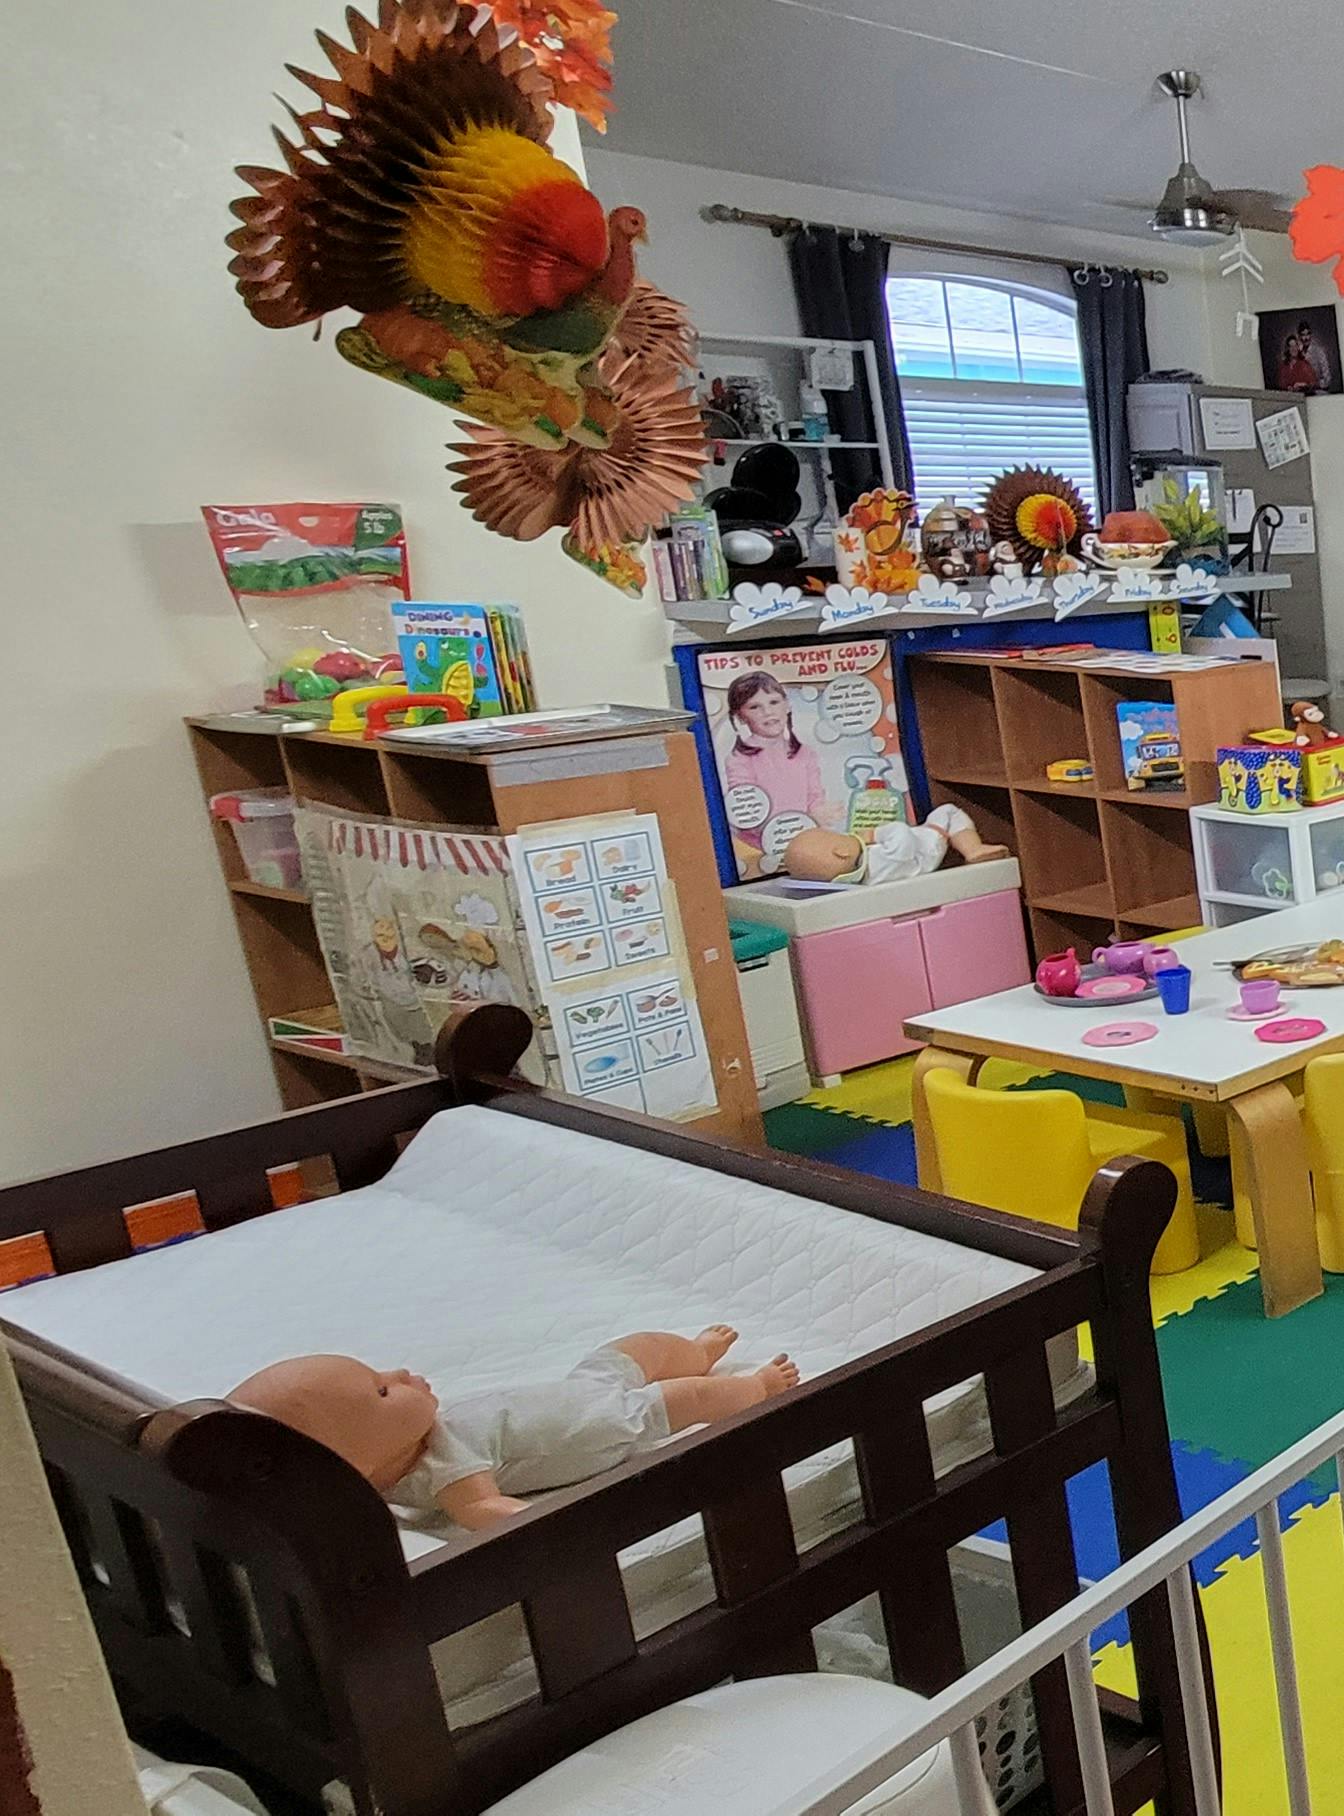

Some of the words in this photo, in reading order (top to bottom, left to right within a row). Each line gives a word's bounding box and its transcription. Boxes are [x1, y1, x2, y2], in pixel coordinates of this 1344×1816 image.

[748, 599, 794, 620] Sunday
[919, 597, 961, 611] Tuesday
[408, 610, 454, 623] DINING
[832, 602, 874, 622] Monday
[404, 623, 471, 636] Dinosaurs
[704, 654, 740, 671] TIPS
[745, 653, 764, 667] TO
[771, 648, 832, 665] PREVENT
[838, 643, 879, 658] COLDS
[798, 662, 828, 677] AND
